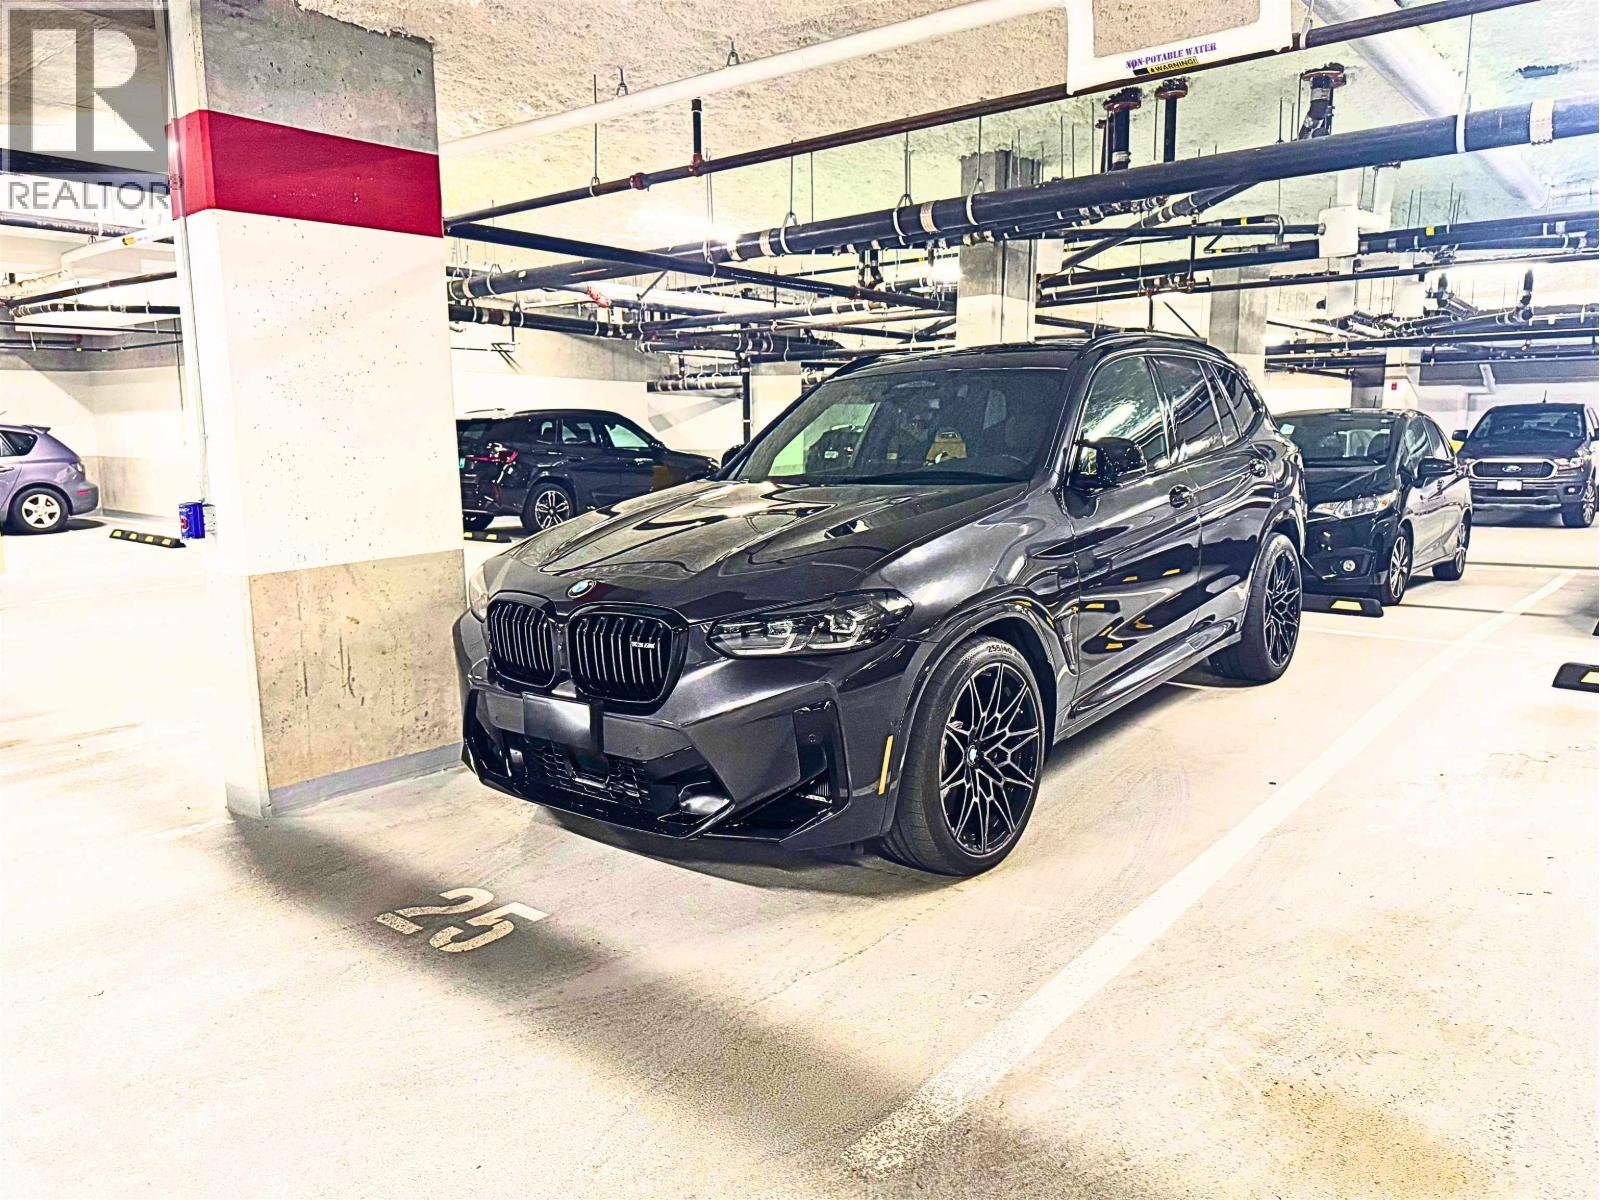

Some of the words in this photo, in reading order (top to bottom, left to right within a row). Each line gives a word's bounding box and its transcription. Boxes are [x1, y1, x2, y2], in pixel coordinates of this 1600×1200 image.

[1126, 49, 1184, 69] NON-POTABLE
[1186, 42, 1217, 56] WATER
[374, 887, 550, 952] 25
